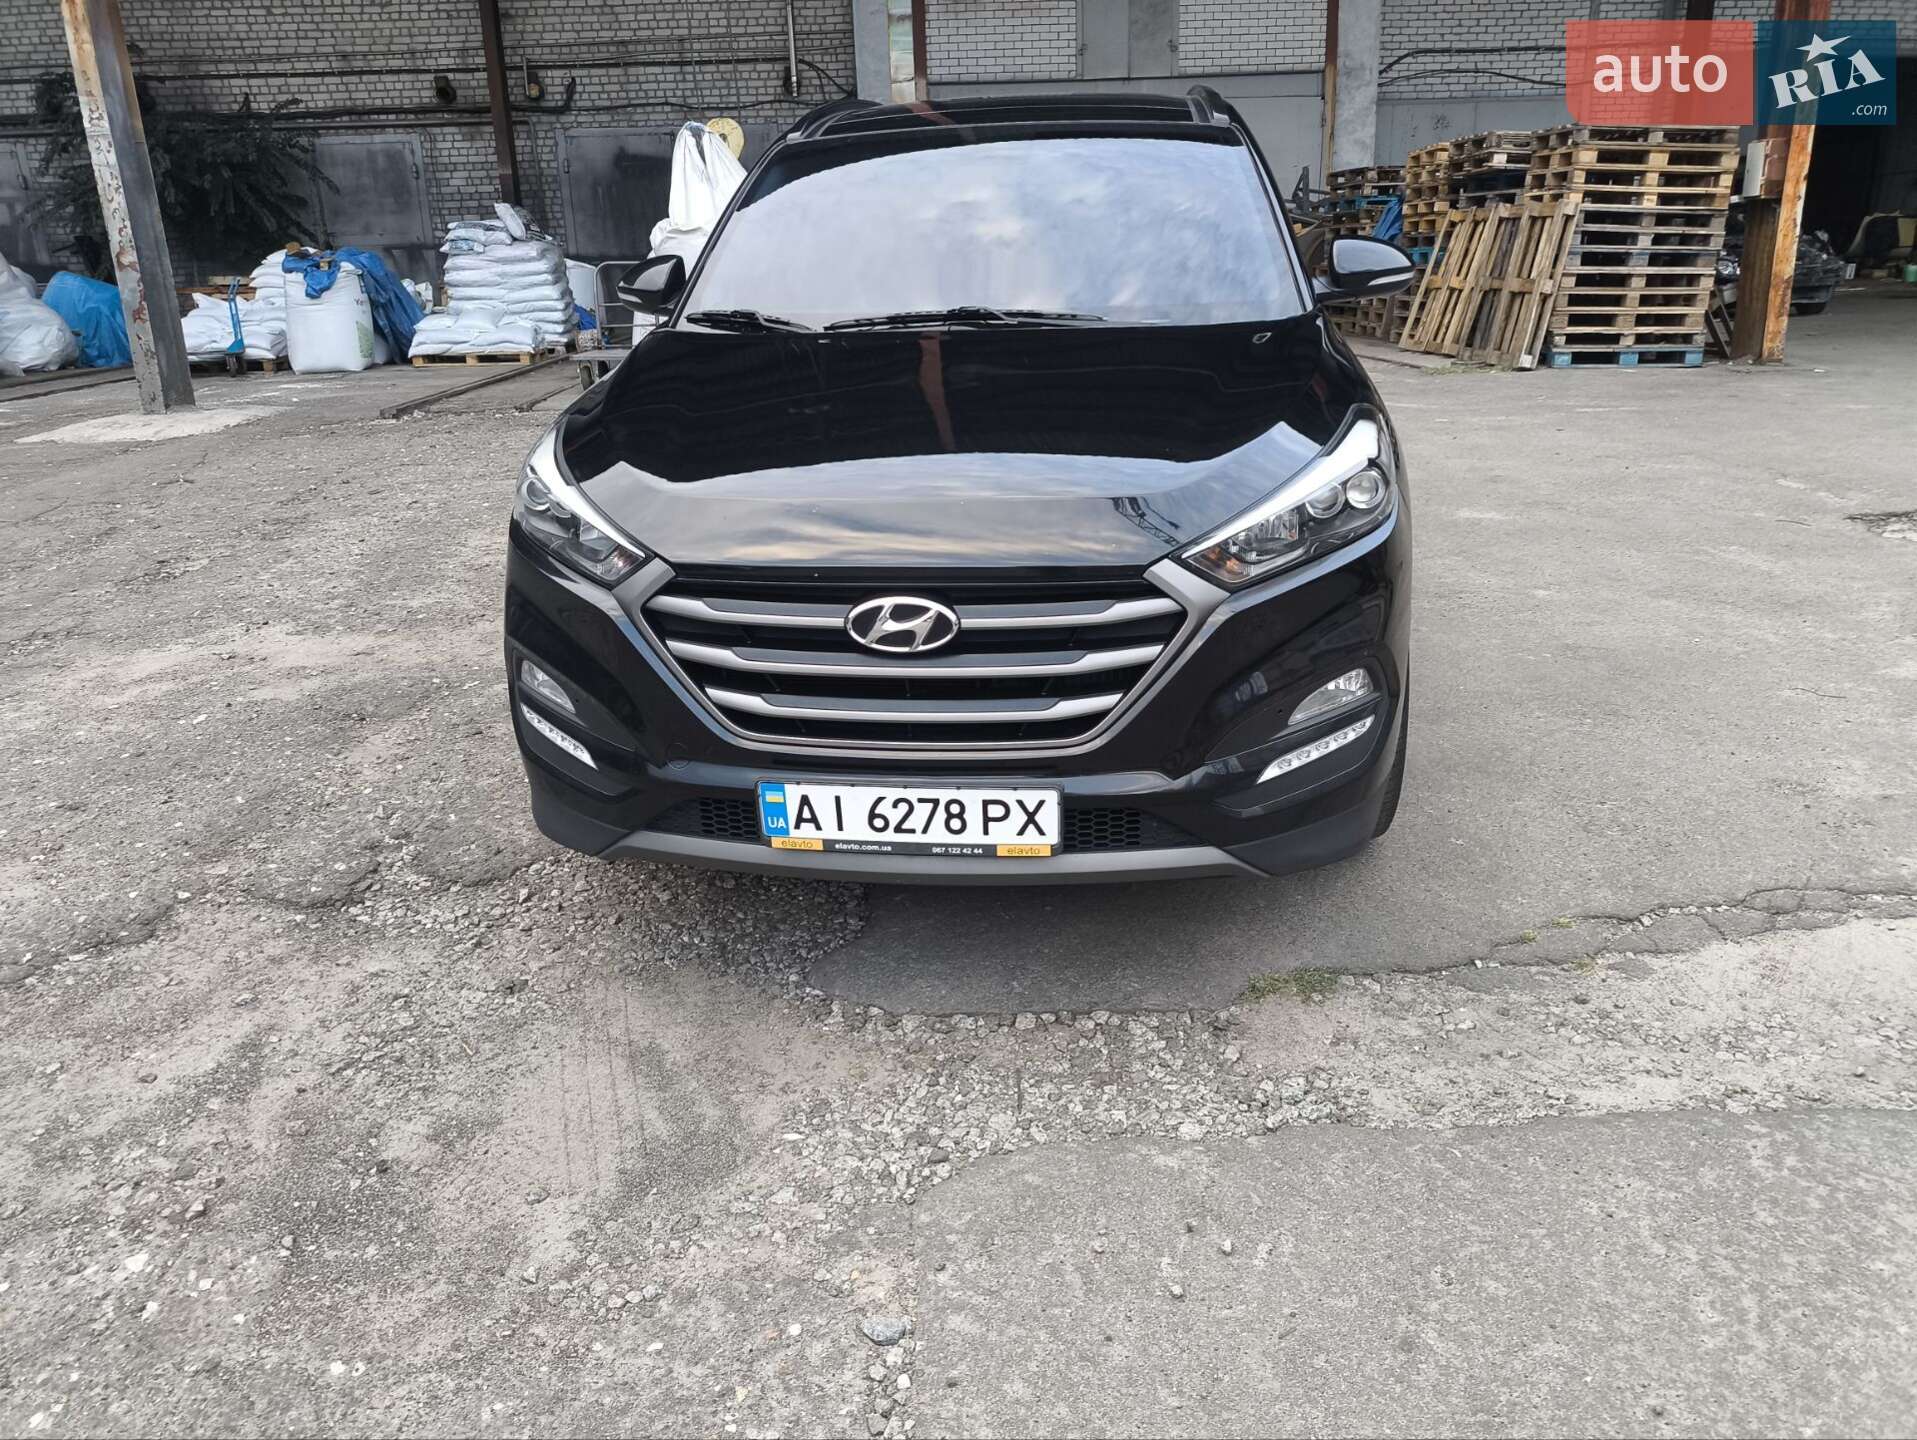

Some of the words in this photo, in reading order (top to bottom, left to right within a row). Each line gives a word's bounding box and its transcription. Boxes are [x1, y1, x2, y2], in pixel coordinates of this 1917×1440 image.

[794, 794, 844, 832] AI
[867, 796, 968, 835] 6278
[982, 799, 1047, 836] PX
[768, 816, 787, 829] UA
[781, 839, 814, 849] elavto
[834, 842, 893, 852] elavto.com.ua
[1006, 846, 1041, 856] elavto
